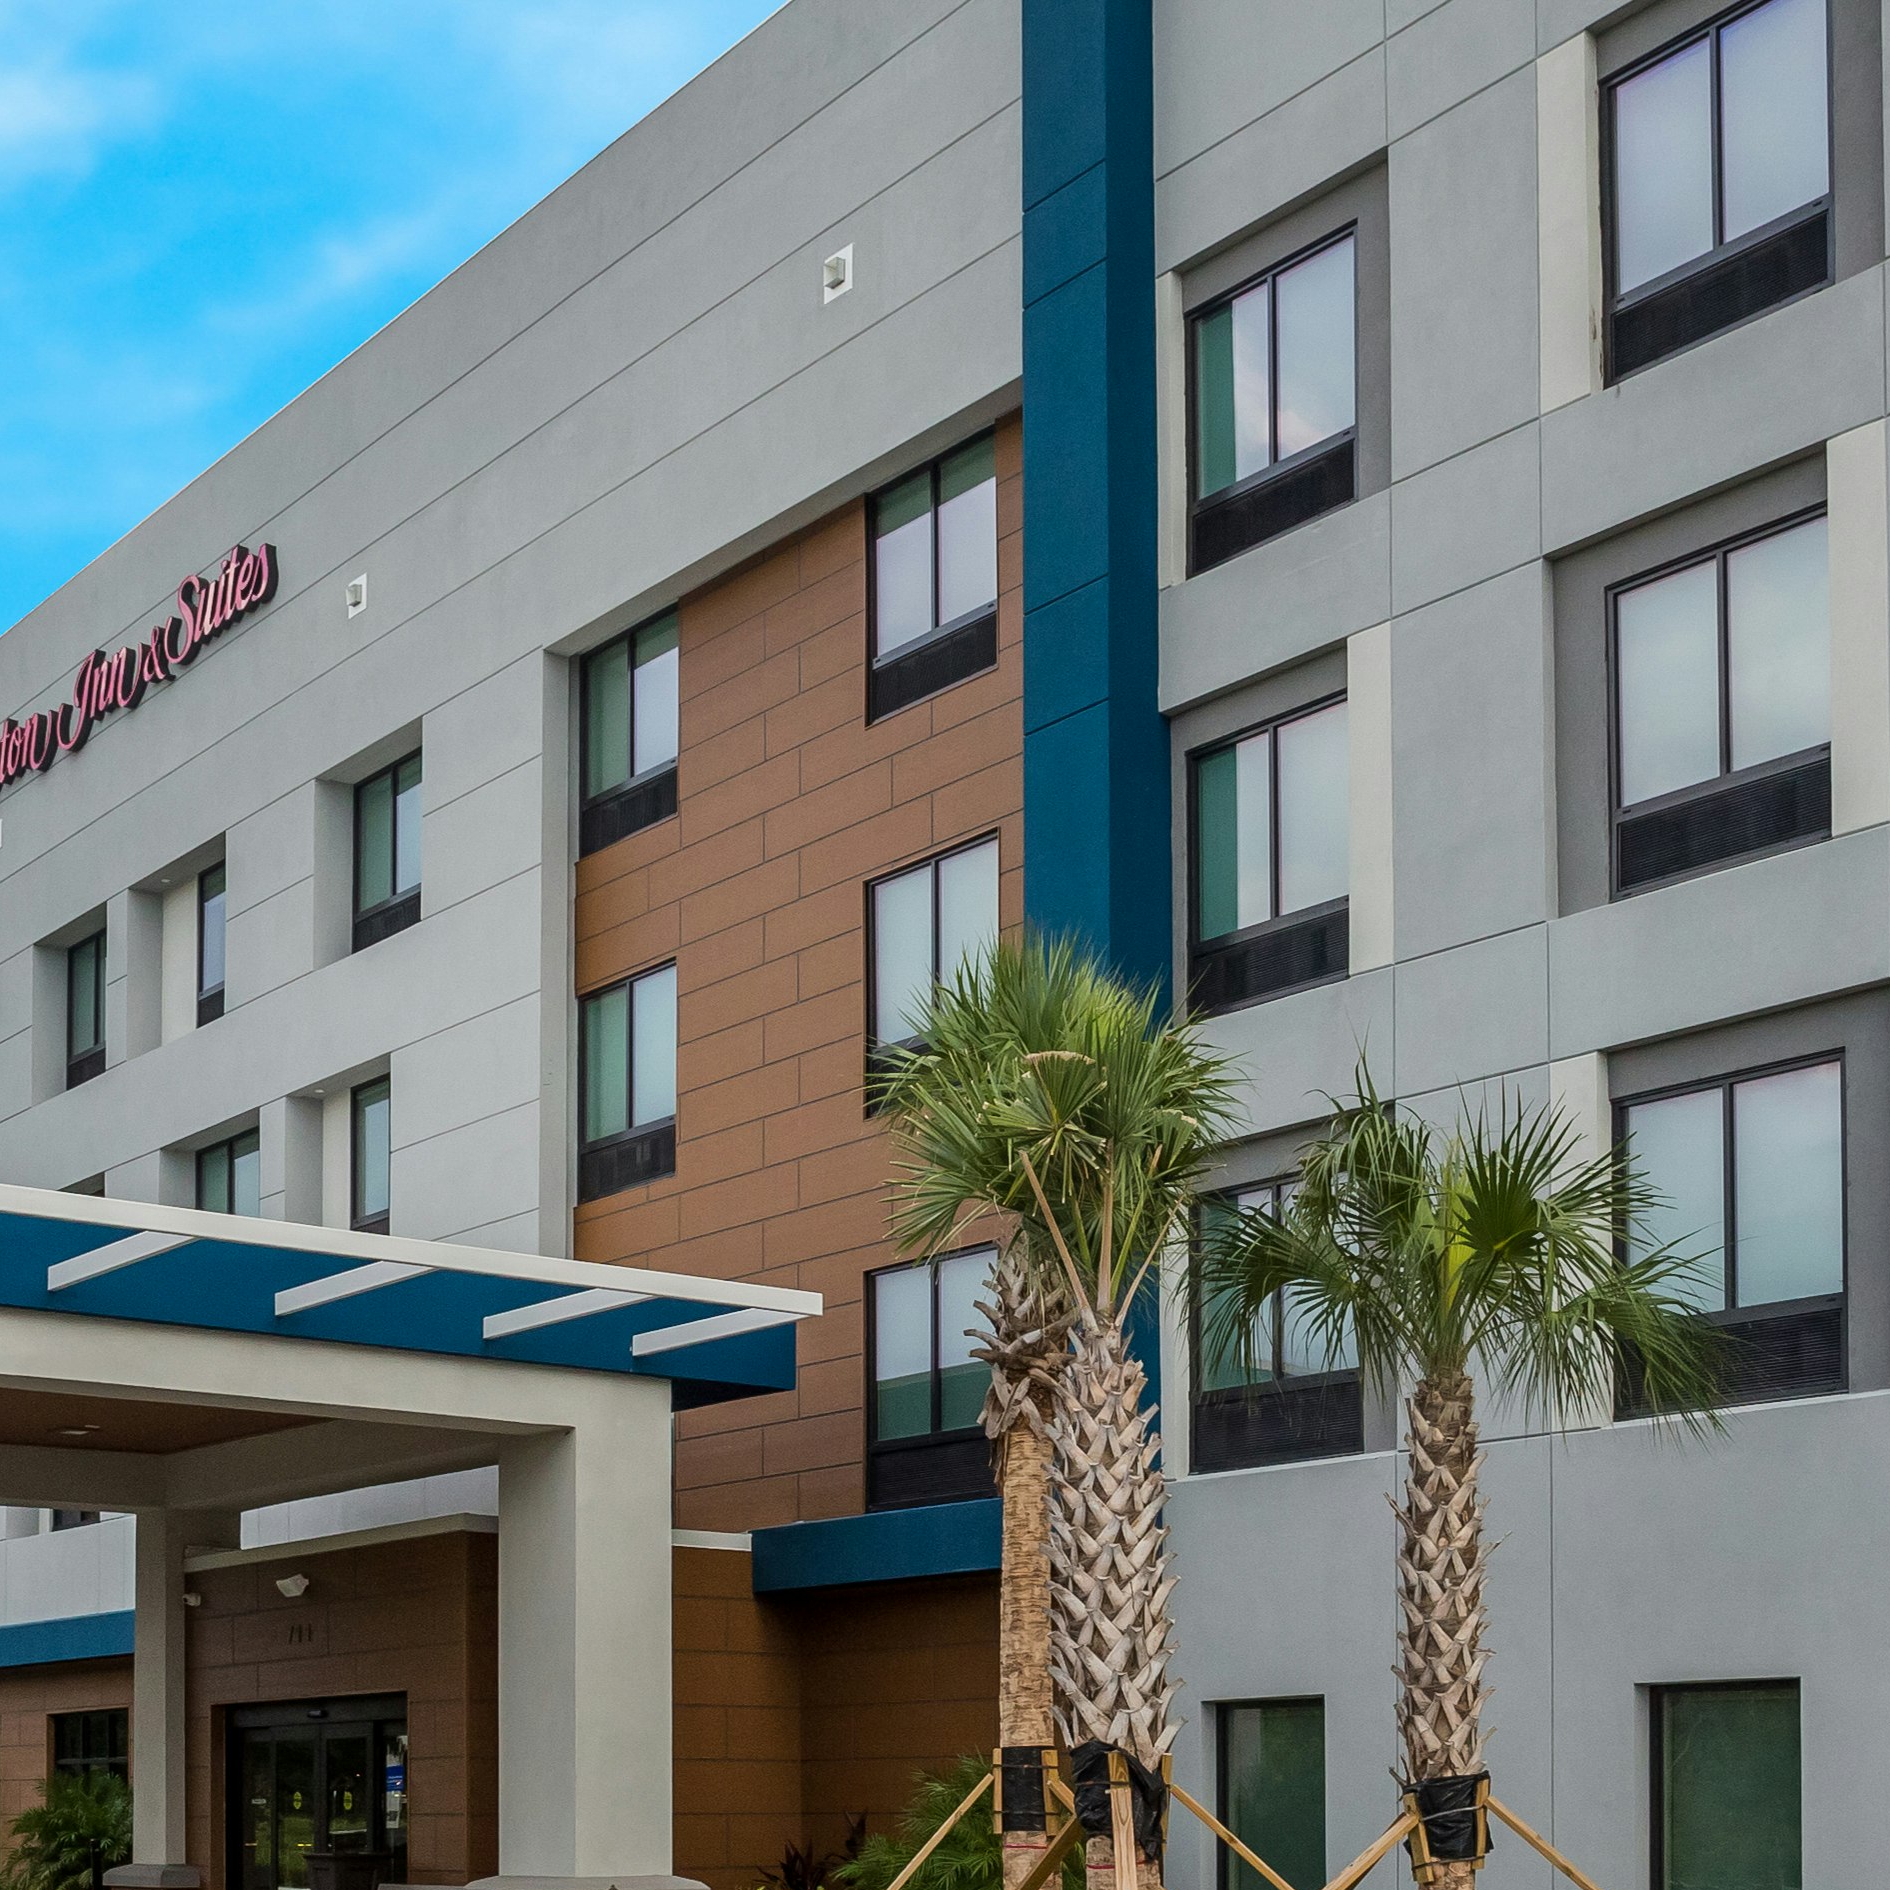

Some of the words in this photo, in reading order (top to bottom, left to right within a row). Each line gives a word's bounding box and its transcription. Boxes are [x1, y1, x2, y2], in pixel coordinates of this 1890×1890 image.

[57, 642, 148, 752] Inn
[142, 626, 176, 681] &
[165, 543, 279, 664] Suites
